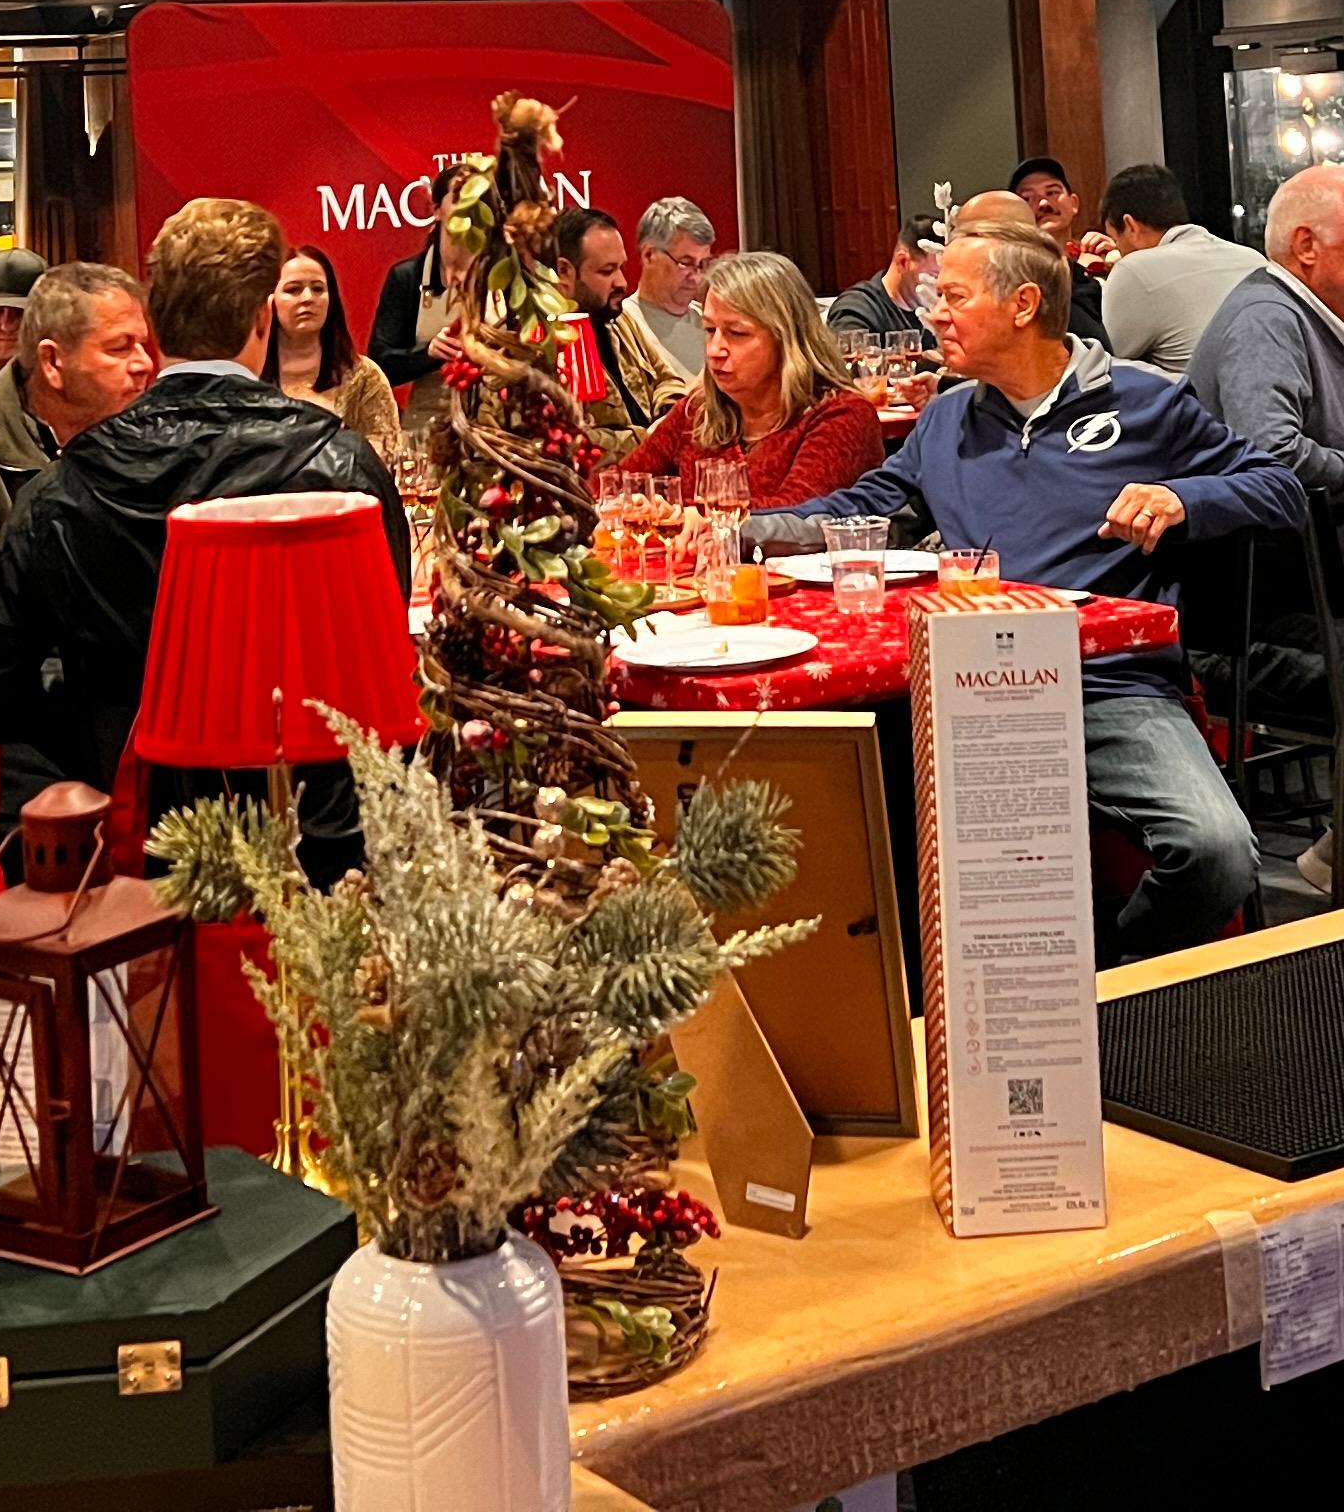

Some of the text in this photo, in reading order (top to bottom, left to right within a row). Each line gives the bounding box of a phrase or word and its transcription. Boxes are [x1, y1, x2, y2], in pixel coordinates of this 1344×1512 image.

[432, 152, 484, 172] TH
[317, 170, 592, 232] MACN
[955, 668, 1058, 688] MACALLAN
